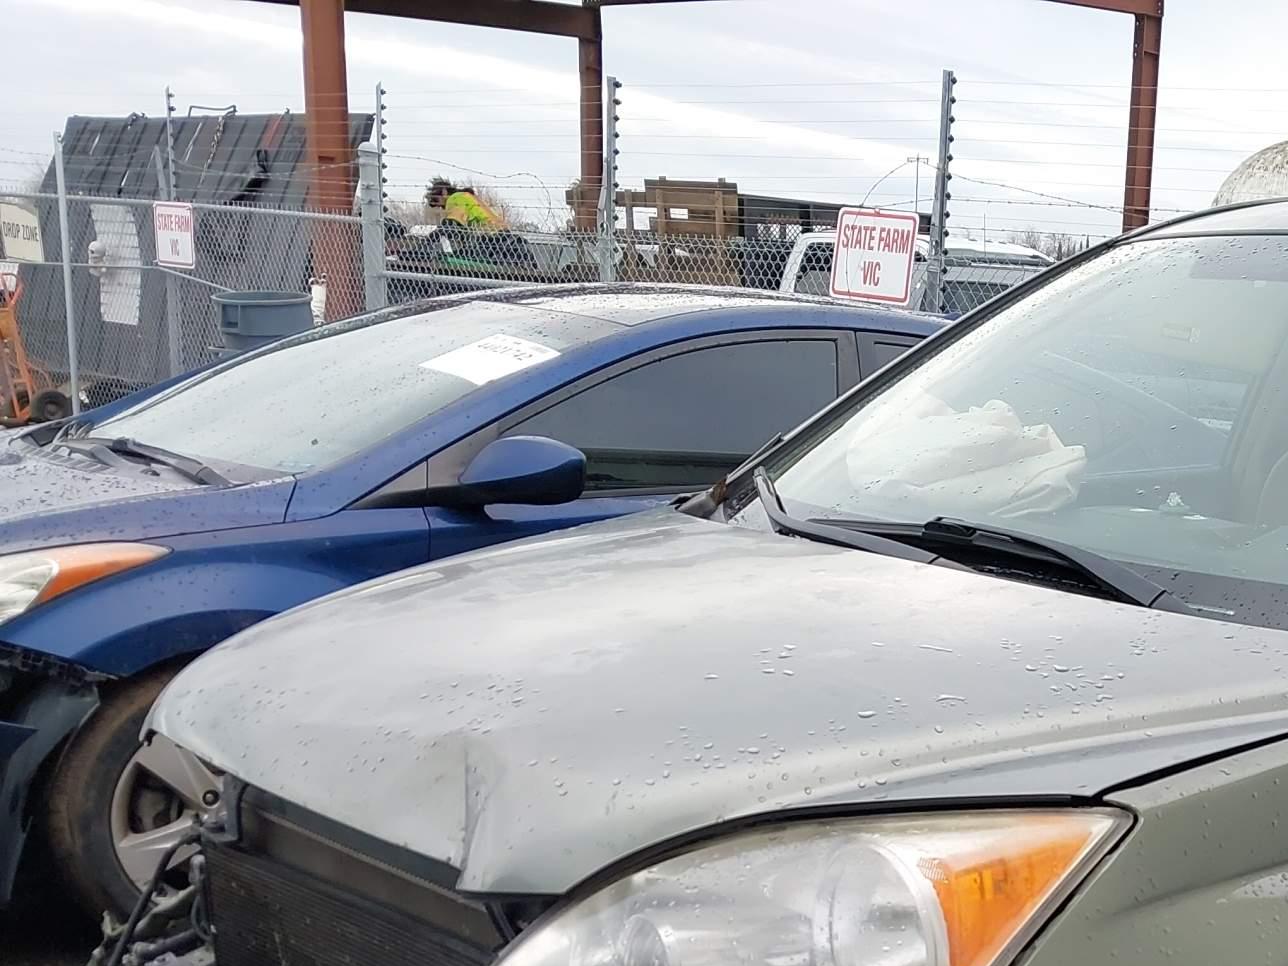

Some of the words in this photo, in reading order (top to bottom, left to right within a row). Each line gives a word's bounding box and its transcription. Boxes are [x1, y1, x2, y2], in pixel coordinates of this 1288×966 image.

[2, 221, 20, 239] DROP
[21, 224, 39, 241] ZONE
[158, 213, 173, 231] STATE
[175, 215, 190, 232] FARM
[842, 224, 876, 251] STATE
[878, 227, 911, 254] FARM
[863, 260, 881, 287] VIC
